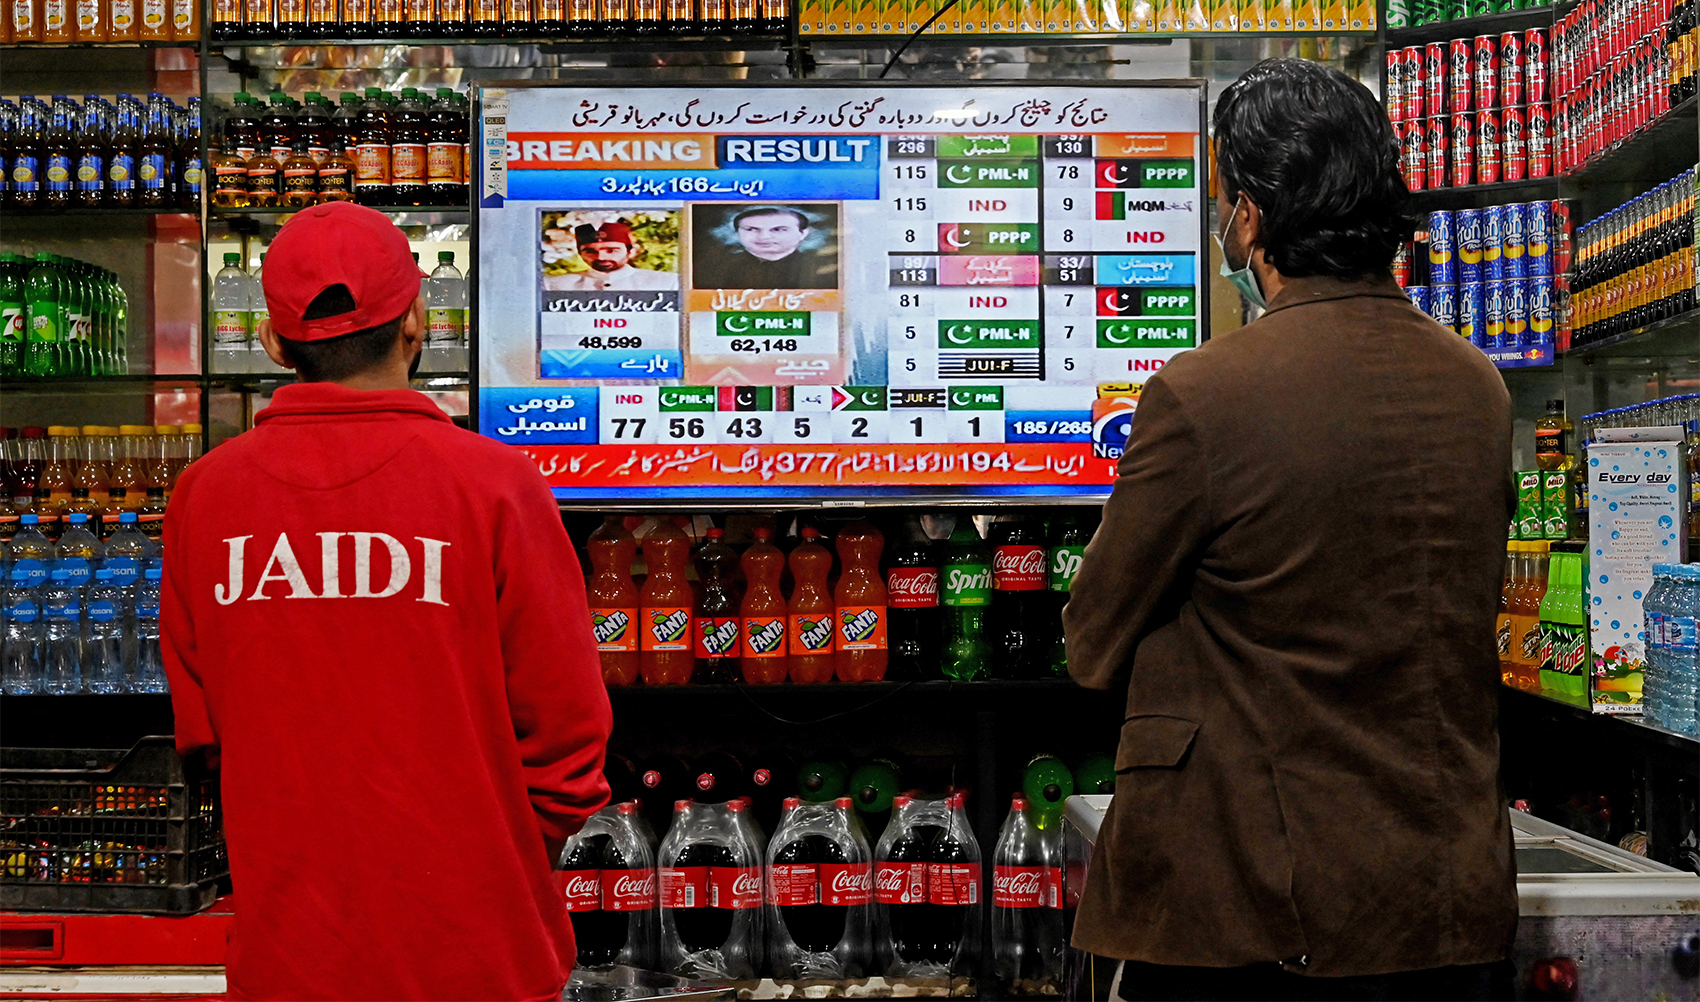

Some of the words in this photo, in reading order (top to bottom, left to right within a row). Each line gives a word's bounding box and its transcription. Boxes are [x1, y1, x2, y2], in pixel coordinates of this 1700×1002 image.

[572, 99, 619, 127] قریشی
[696, 102, 750, 127] کروں
[746, 105, 826, 125] درخواست
[829, 101, 852, 127] کی
[849, 97, 885, 128] گنتی
[878, 109, 923, 129] دوبارہ
[972, 103, 1025, 127] کروں
[1020, 98, 1051, 127] چیلنج
[1055, 102, 1075, 125] کو
[1071, 98, 1108, 127] نتائج
[506, 140, 702, 162] BREAKING
[727, 140, 869, 162] RESULT
[898, 142, 926, 153] 296
[963, 144, 1010, 156] اسمبلی
[1055, 142, 1082, 153] 130
[894, 166, 926, 179] 115
[978, 168, 1029, 180] PML-N
[1057, 166, 1079, 179] 78
[1146, 168, 1188, 180] PPPP
[602, 177, 617, 192] 3
[669, 177, 708, 192] 166
[709, 180, 738, 192] اے
[740, 179, 764, 196] این
[893, 198, 926, 211] 115
[968, 200, 1007, 212] IND
[1063, 198, 1073, 211] 9
[1128, 200, 1165, 212] MQM
[905, 229, 915, 242] 8
[989, 231, 1031, 243] PPPP
[1063, 229, 1073, 242] 8
[1127, 231, 1165, 243] IND
[900, 270, 927, 281] 113
[1060, 270, 1076, 281] 51
[900, 294, 919, 307] 81
[969, 296, 1008, 308] IND
[1064, 294, 1074, 307] 7
[1147, 296, 1189, 308] PPPP
[594, 318, 627, 328] IND
[755, 318, 803, 329] PML-N
[905, 326, 916, 339] 5
[979, 327, 1030, 340] PML-N
[1064, 326, 1074, 339] 7
[1137, 328, 1188, 340] PML-N
[578, 336, 642, 350] 48,599
[730, 339, 797, 353] 62,148
[1489, 353, 1501, 361] YOU
[905, 358, 916, 371] 5
[968, 360, 1011, 371] JUI-F
[1064, 358, 1074, 370] 5
[1128, 359, 1165, 371] IND
[508, 394, 575, 413] قومی
[615, 394, 643, 404] IND
[679, 394, 714, 404] PML-N
[904, 393, 935, 403] JUI-F
[975, 394, 999, 403] PML
[497, 416, 586, 435] اسمبلی
[611, 418, 646, 438] 77
[669, 418, 704, 438] 56
[726, 418, 762, 437] 43
[794, 417, 811, 437] 5
[851, 417, 868, 437] 2
[910, 417, 922, 437] 1
[968, 417, 980, 437] 1
[641, 453, 660, 473] کا
[776, 452, 836, 473] 377
[958, 451, 1011, 472] 194
[1013, 455, 1051, 472] اے
[1053, 455, 1084, 476] این
[1523, 478, 1538, 487] MILO
[1548, 478, 1563, 486] MILO
[1598, 473, 1641, 484] Every
[1646, 472, 1672, 484] day
[993, 550, 1046, 574] Coca-Cola
[214, 532, 451, 606] JAIDI
[888, 573, 938, 595] Coca-Cola
[947, 568, 993, 594] Sprit
[592, 610, 629, 642] FANTA
[652, 609, 689, 642] FANTA
[841, 608, 878, 641] FANTA
[702, 620, 738, 653] FANTA
[748, 619, 784, 653] FANTA
[799, 616, 833, 649] FANTA
